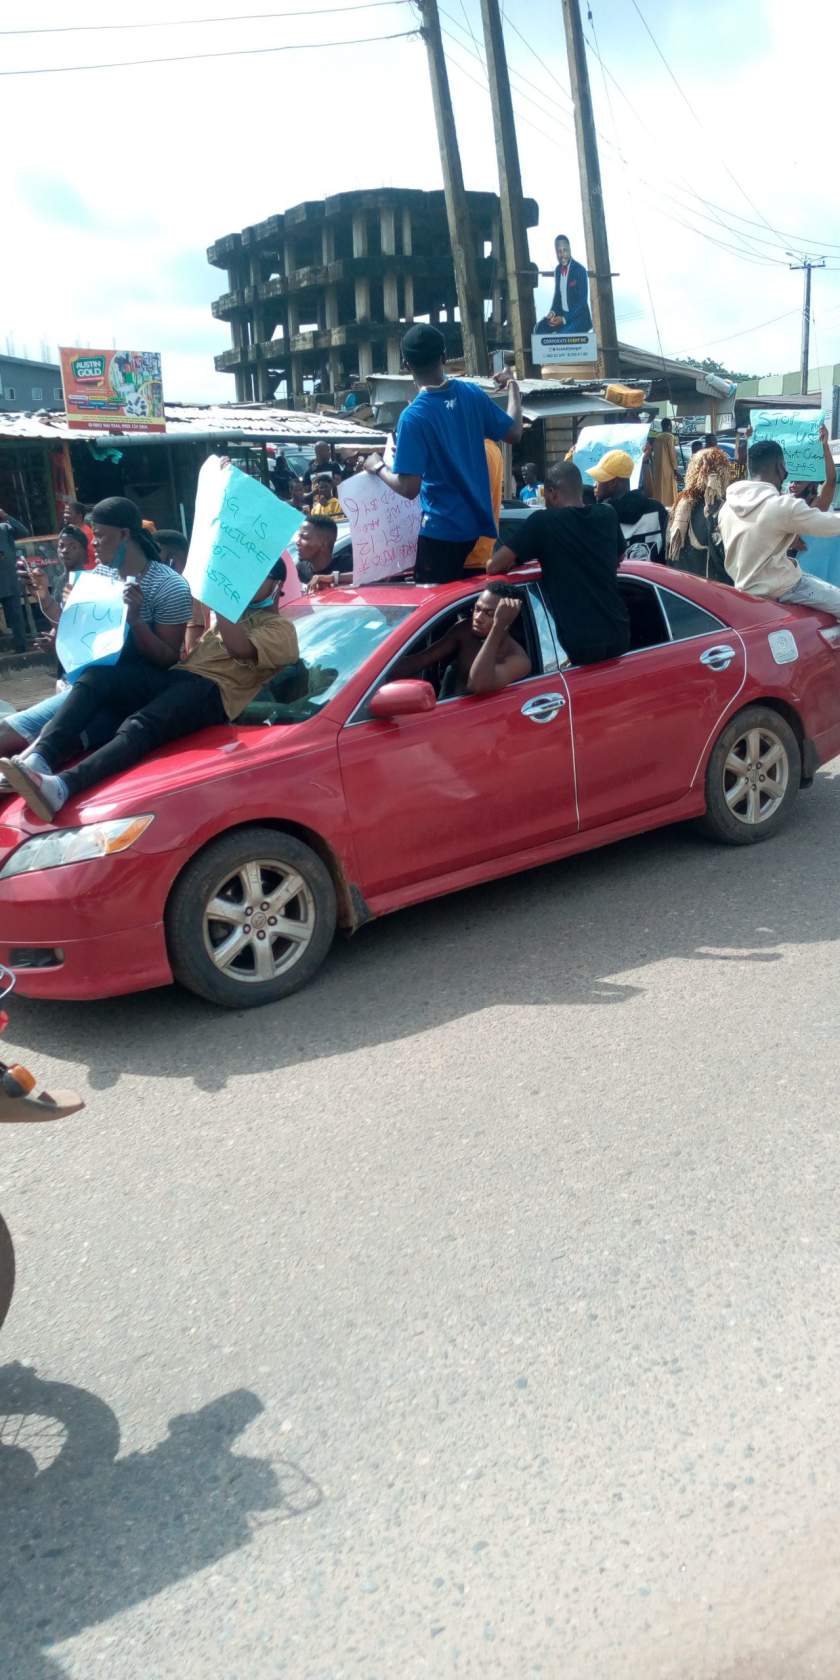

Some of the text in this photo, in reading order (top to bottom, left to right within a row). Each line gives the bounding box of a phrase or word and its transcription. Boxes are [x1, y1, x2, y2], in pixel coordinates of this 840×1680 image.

[76, 360, 102, 369] AUSTIN
[77, 368, 102, 377] GOLD
[759, 412, 800, 427] STOP
[251, 513, 268, 540] IS
